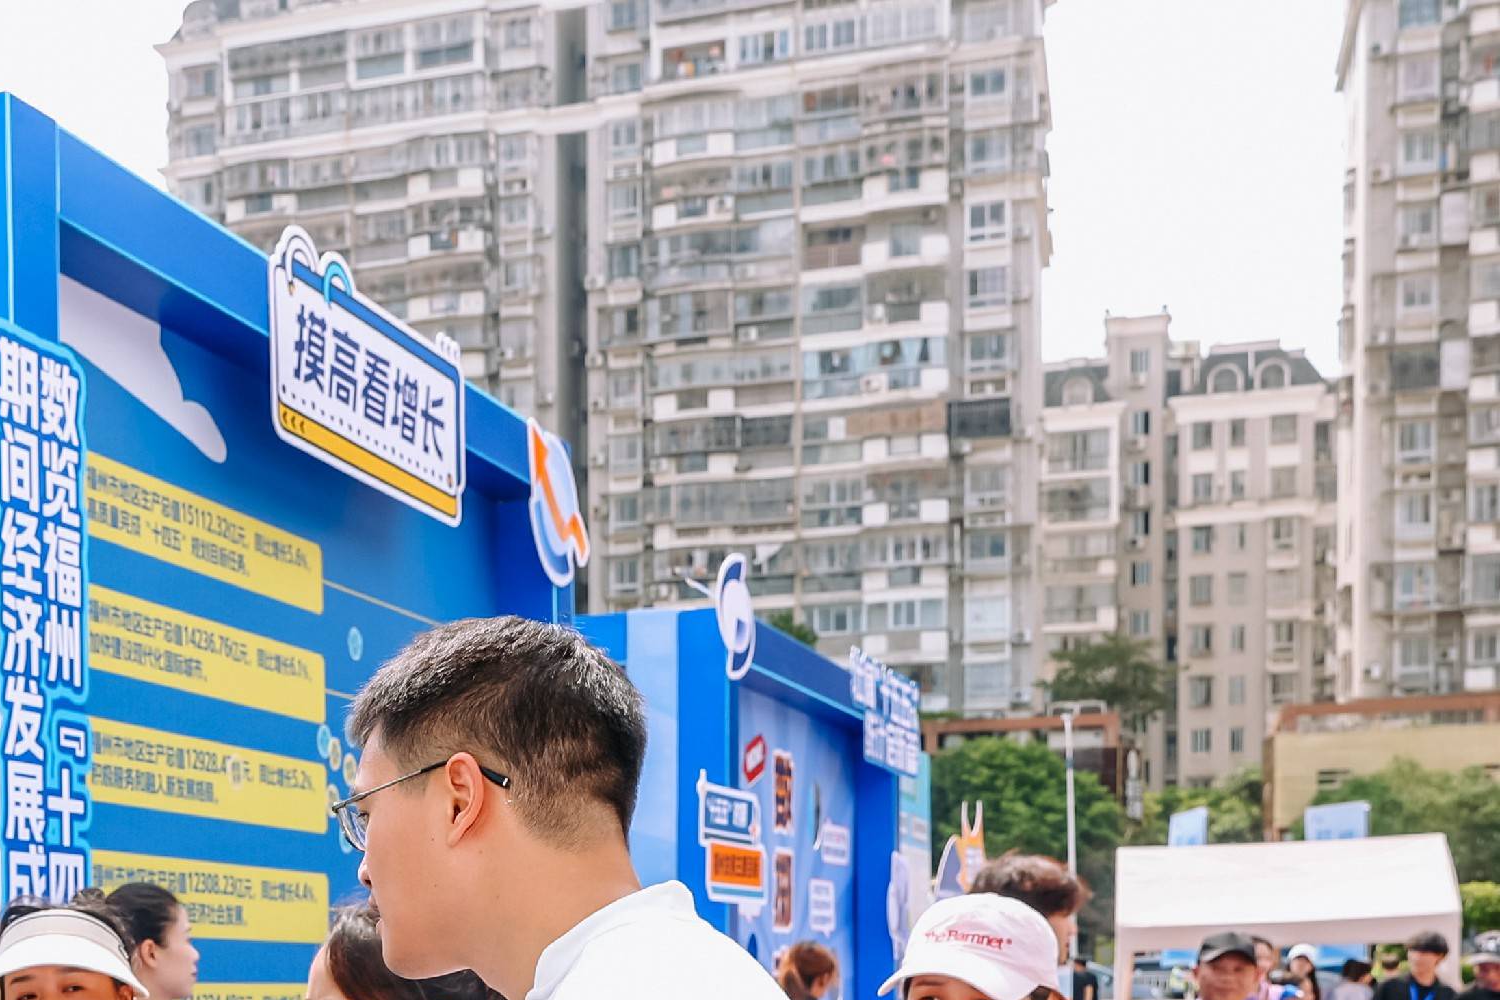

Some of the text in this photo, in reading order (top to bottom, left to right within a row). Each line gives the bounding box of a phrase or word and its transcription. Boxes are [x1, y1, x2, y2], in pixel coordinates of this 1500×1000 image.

[294, 304, 444, 462] 摸高看增长
